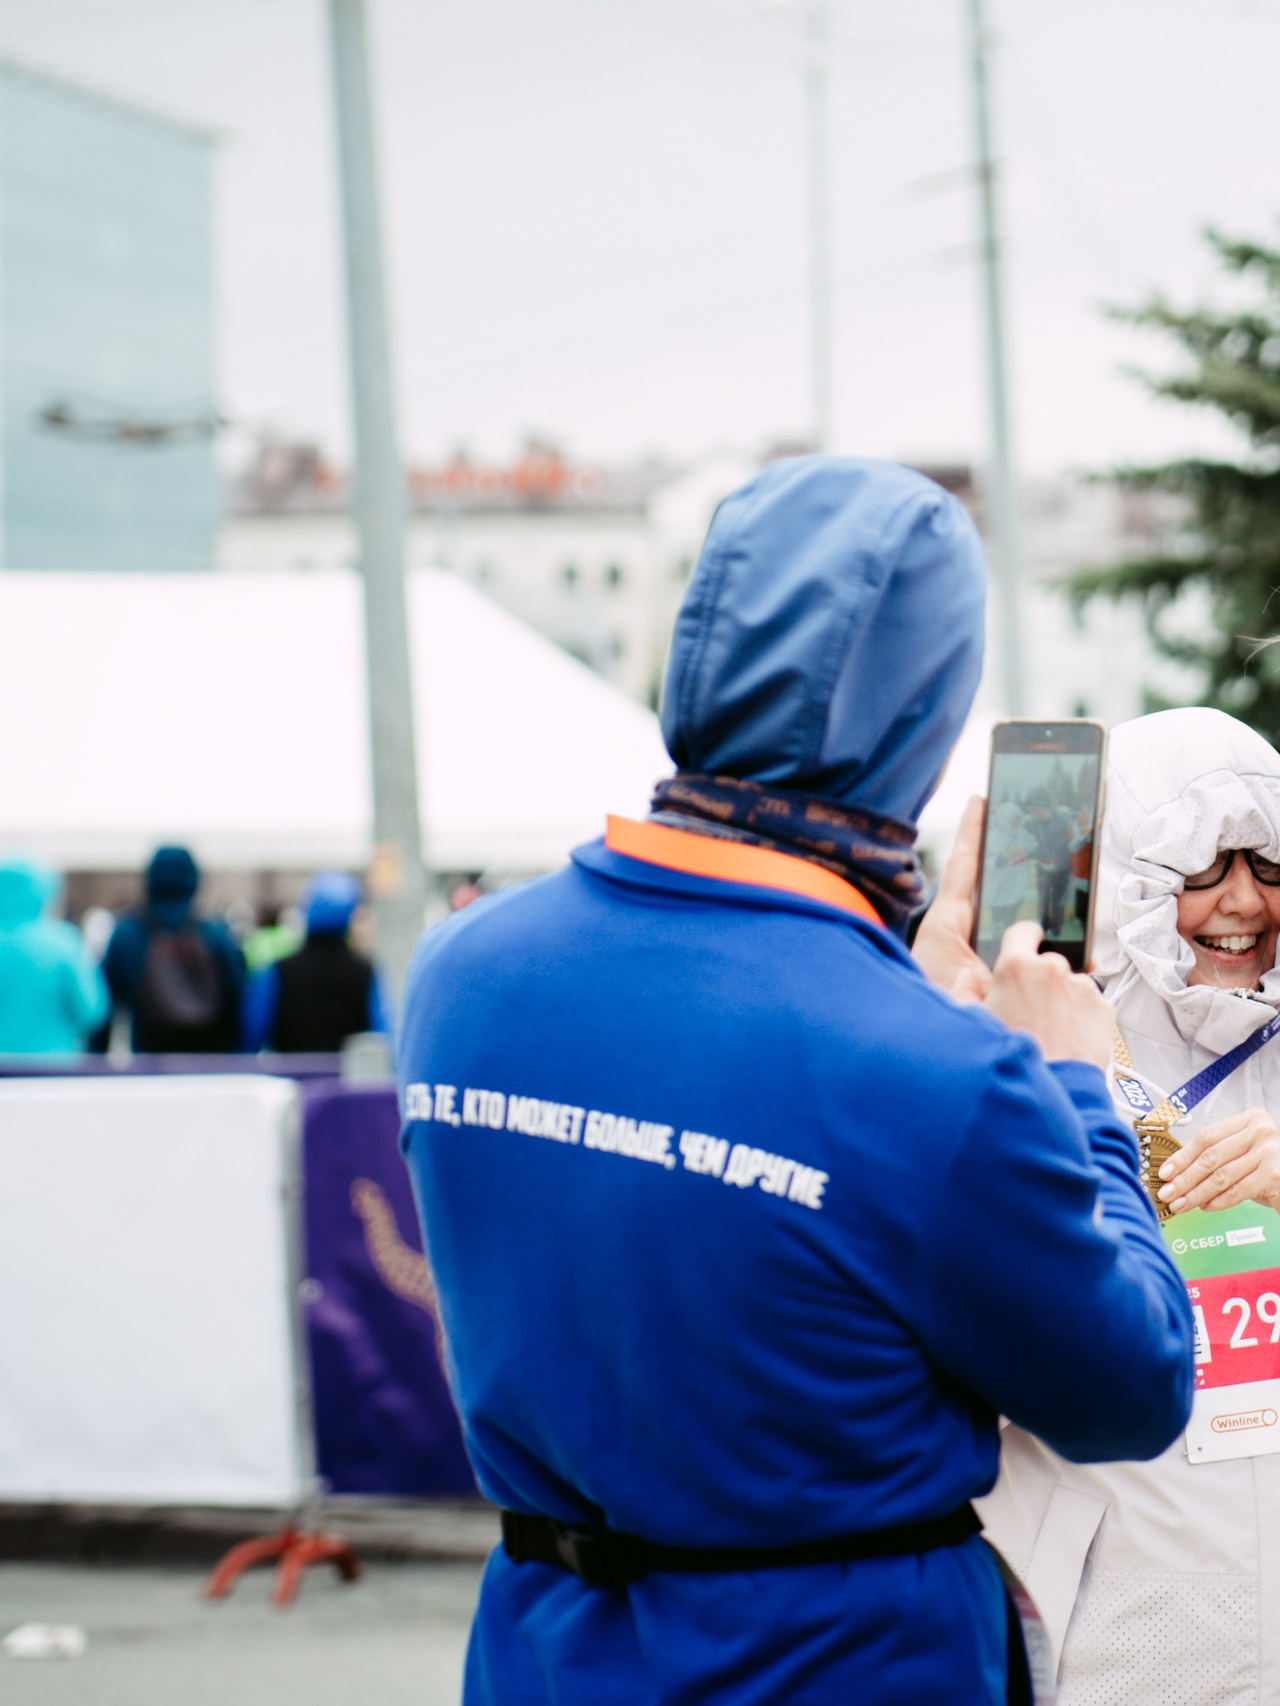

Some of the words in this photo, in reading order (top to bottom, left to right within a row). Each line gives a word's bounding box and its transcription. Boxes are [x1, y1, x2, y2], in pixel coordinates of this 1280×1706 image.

[1117, 1078, 1151, 1107] 2025
[1171, 1095, 1188, 1113] 3
[462, 1088, 506, 1130] КТО
[506, 1094, 586, 1146] МОЖЕТ
[583, 1110, 677, 1171] БОЛЬШЕ,
[679, 1130, 730, 1179] ЧЕМ
[722, 1143, 830, 1210] ДРУГИЕ
[1190, 1235, 1225, 1250] СБЕР
[1216, 1416, 1260, 1429] Winline
